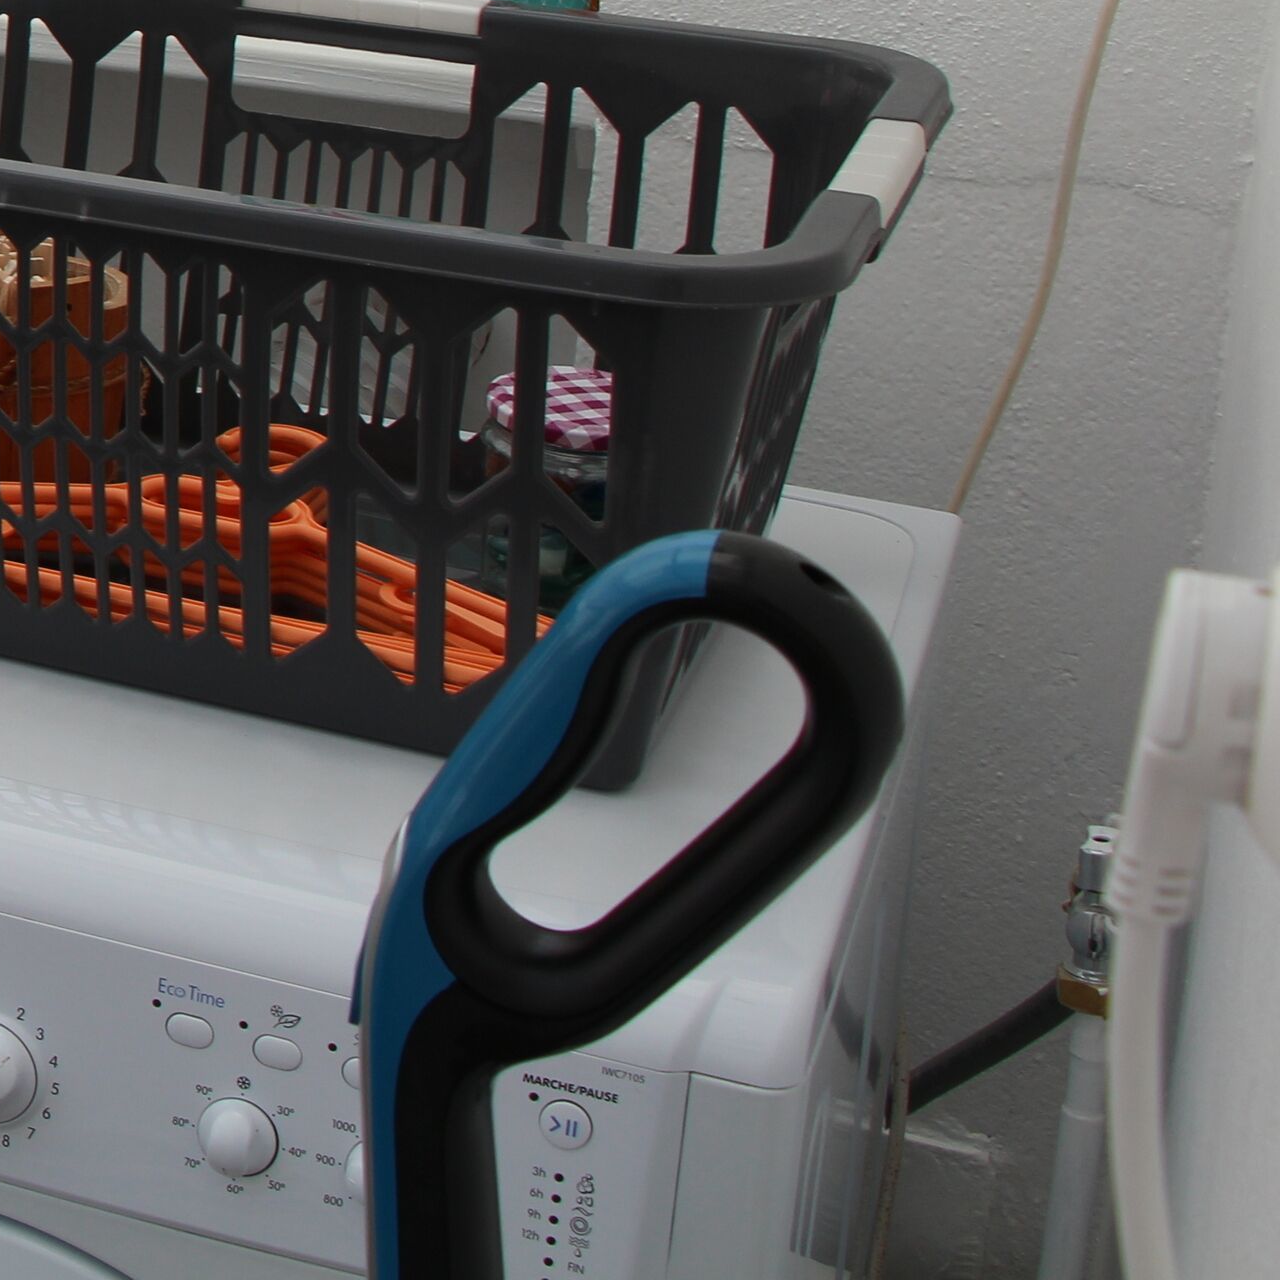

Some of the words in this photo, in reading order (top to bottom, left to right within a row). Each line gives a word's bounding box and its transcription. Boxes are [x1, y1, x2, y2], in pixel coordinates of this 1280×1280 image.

[16, 1007, 25, 1021] 2
[36, 1027, 44, 1041] 3
[49, 1056, 58, 1068] 4
[50, 1083, 59, 1096] 5
[522, 1073, 620, 1104] MARCHE/PAUSE
[42, 1107, 51, 1120] 6
[332, 1118, 356, 1133] 1000
[26, 1127, 37, 1140] 7
[1, 1134, 10, 1148] 8
[315, 1153, 336, 1166] 900
[532, 1166, 547, 1178] 3h
[529, 1188, 544, 1199] 6h
[323, 1194, 344, 1207] 800
[527, 1208, 541, 1220] 9h
[522, 1228, 540, 1241] 12h
[567, 1262, 585, 1275] FIN
